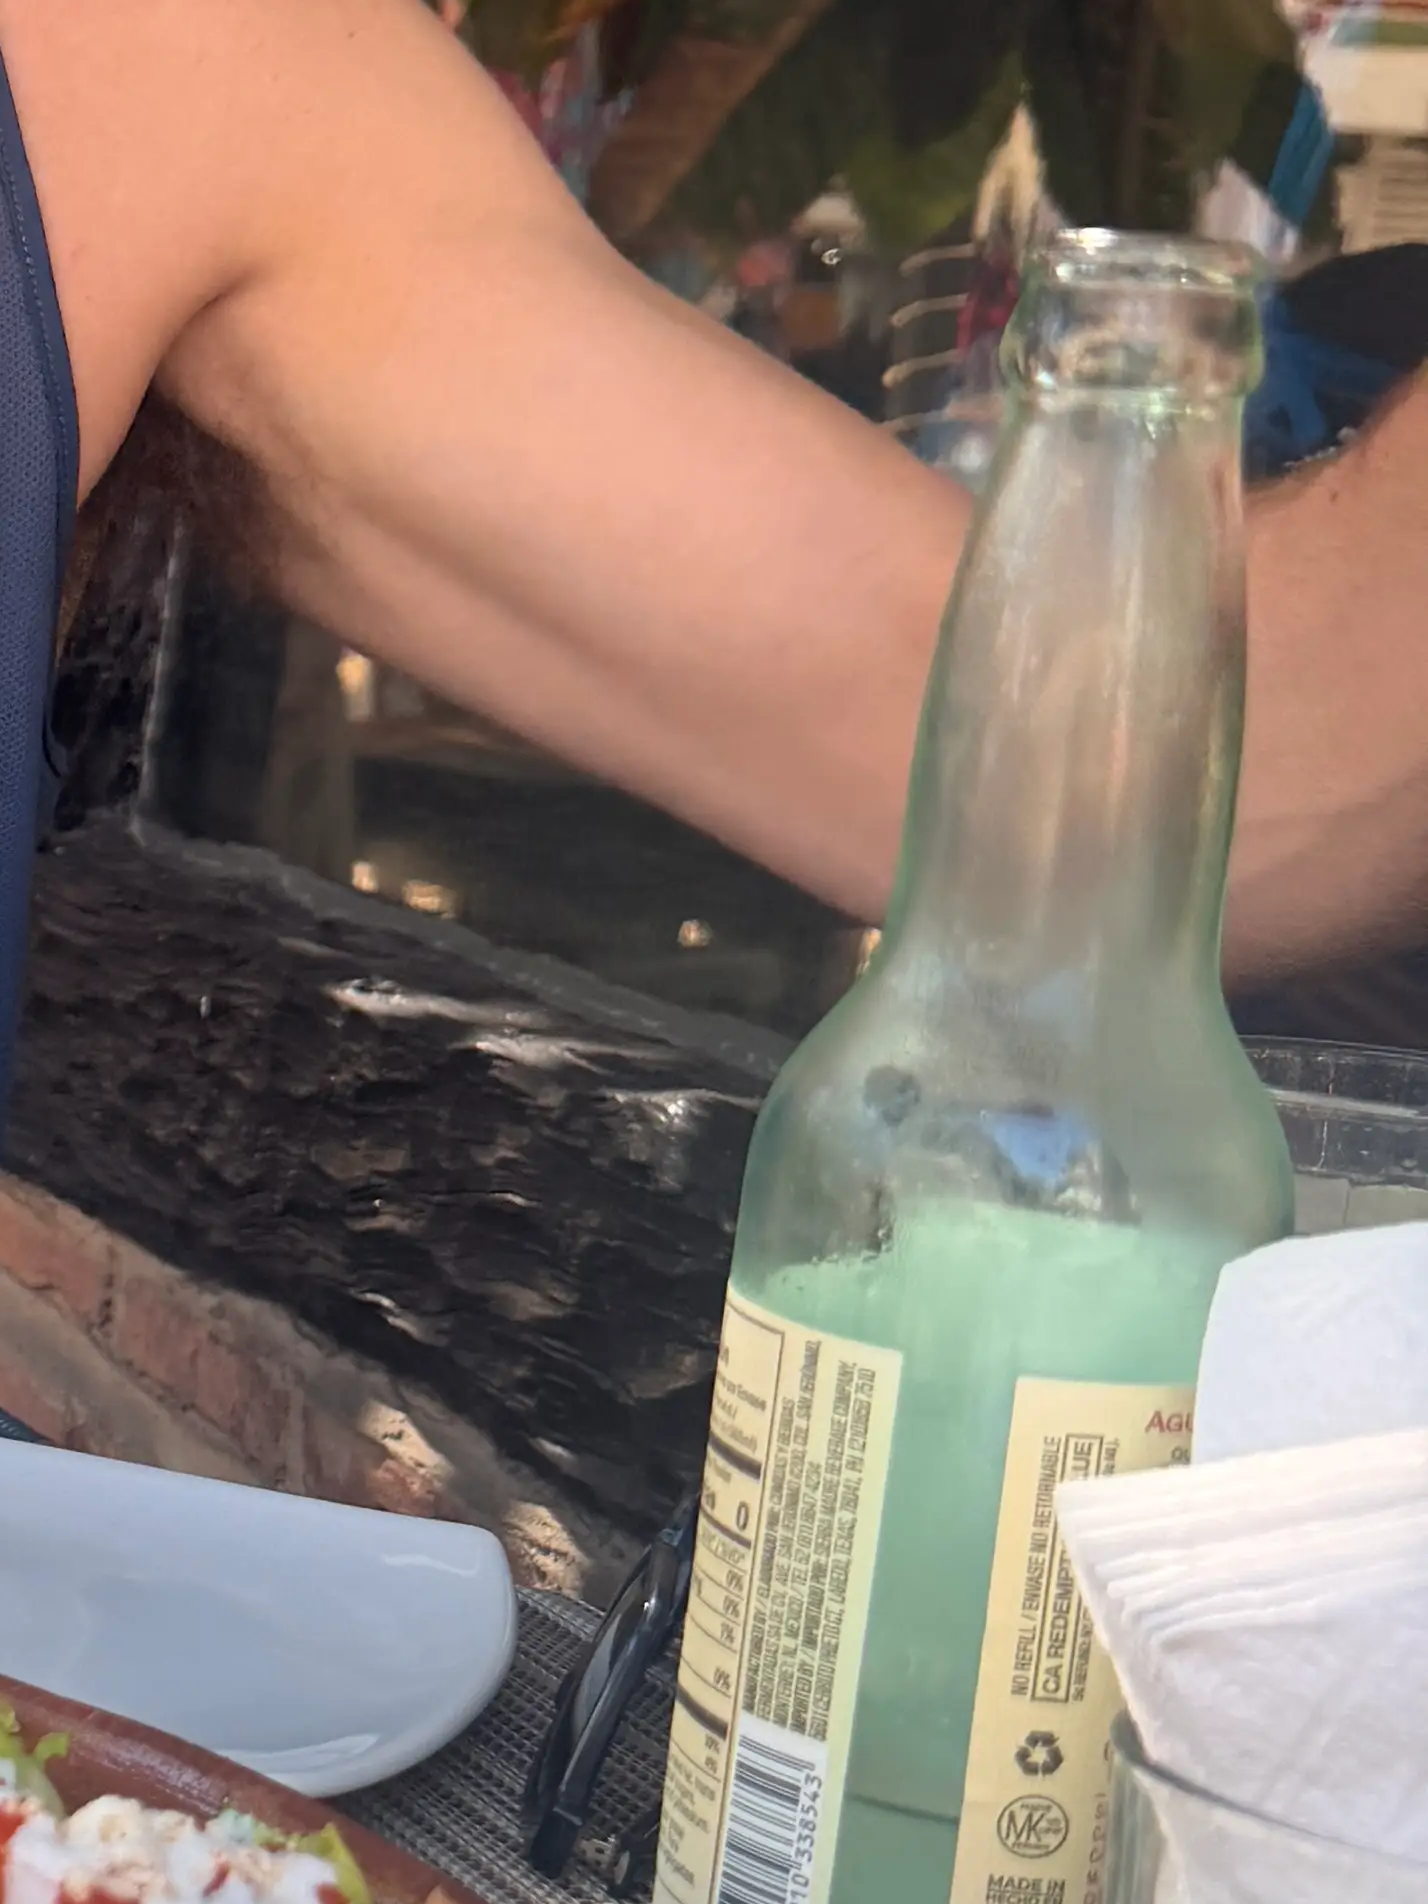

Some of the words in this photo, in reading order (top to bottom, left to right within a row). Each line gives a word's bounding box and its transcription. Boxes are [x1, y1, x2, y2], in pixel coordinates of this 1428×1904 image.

[1028, 1532, 1047, 1553] NO
[1021, 1556, 1045, 1611] ENVASE
[1046, 1550, 1077, 1659] REDEMPT
[1014, 1625, 1036, 1671] REFILL
[1011, 1675, 1029, 1695] NO
[1041, 1664, 1063, 1694] CA
[795, 1773, 822, 1863] 338543
[988, 1874, 1042, 1891] MADE
[1047, 1879, 1065, 1895] IN
